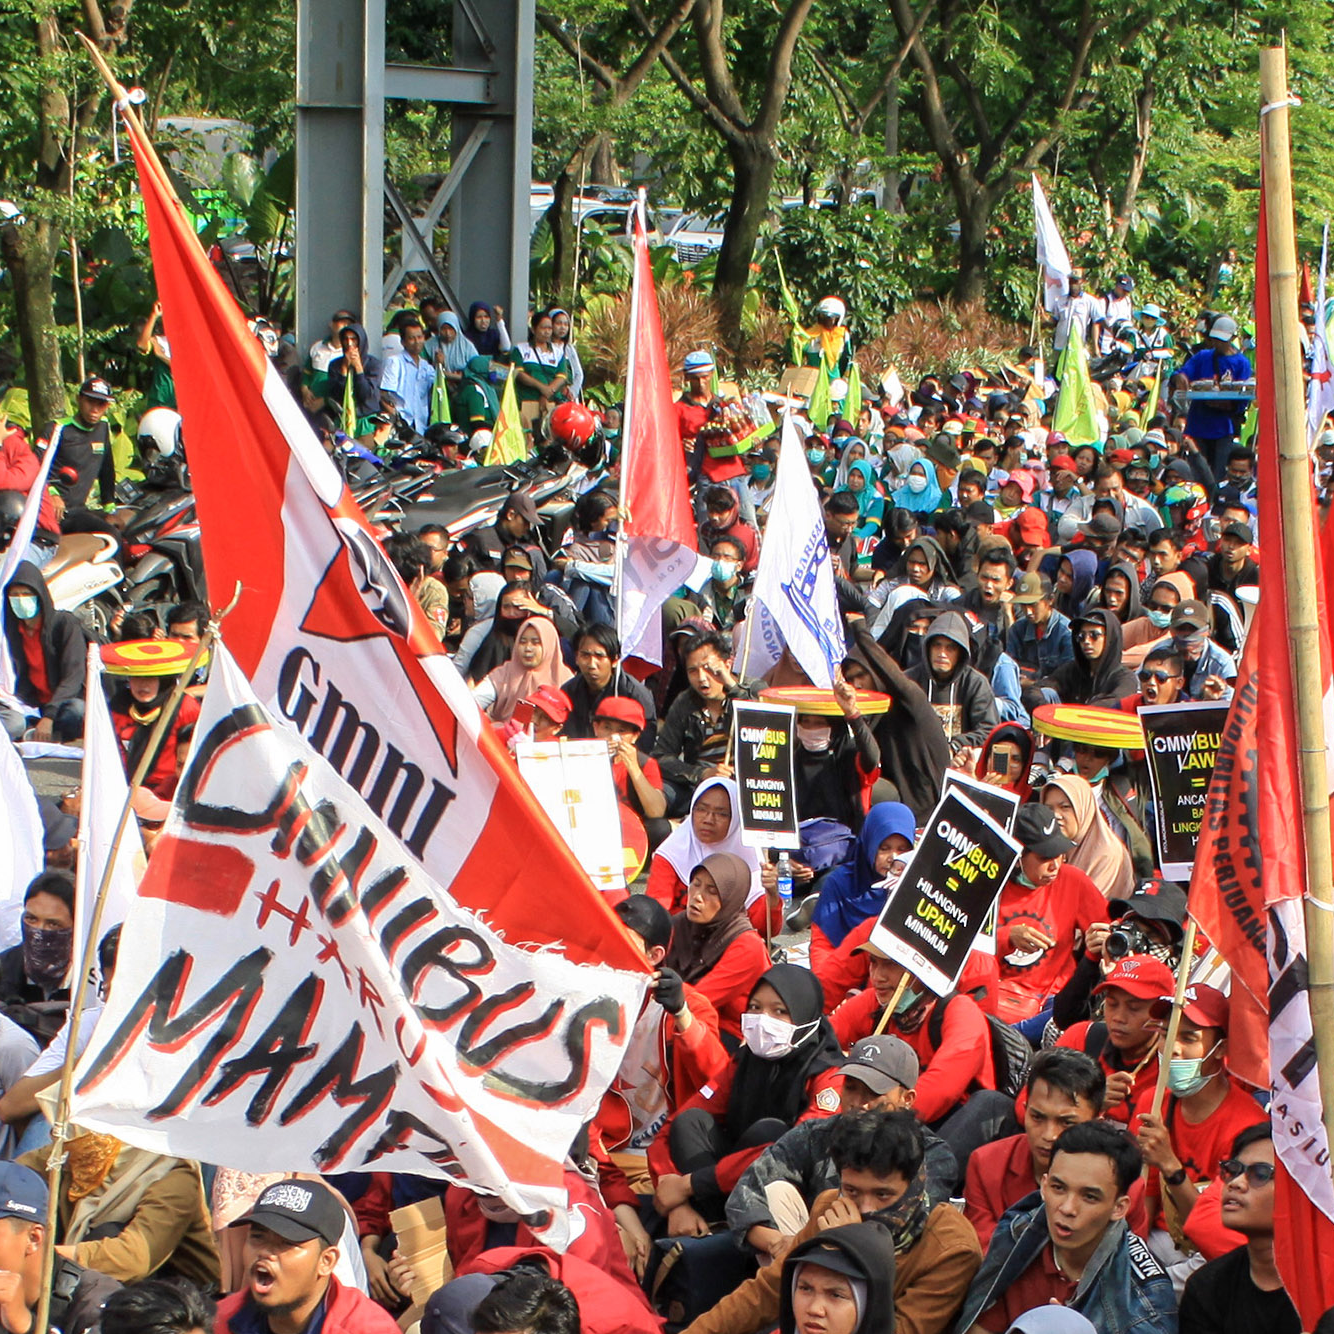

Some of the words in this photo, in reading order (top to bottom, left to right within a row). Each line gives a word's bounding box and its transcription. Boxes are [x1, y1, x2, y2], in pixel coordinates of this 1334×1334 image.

[740, 728, 786, 745] OMNIBUS
[752, 743, 777, 760] LAW
[1177, 751, 1215, 773] LAW
[746, 778, 785, 791] HILANGNYA
[752, 792, 781, 807] UPAH
[936, 819, 1000, 881] OMNIBUS
[942, 848, 980, 885] LAW
[916, 877, 969, 928] HILANGNYA
[915, 897, 957, 940] UPAH
[904, 914, 950, 957] MINIMUM
[6, 1199, 37, 1215] Supreme
